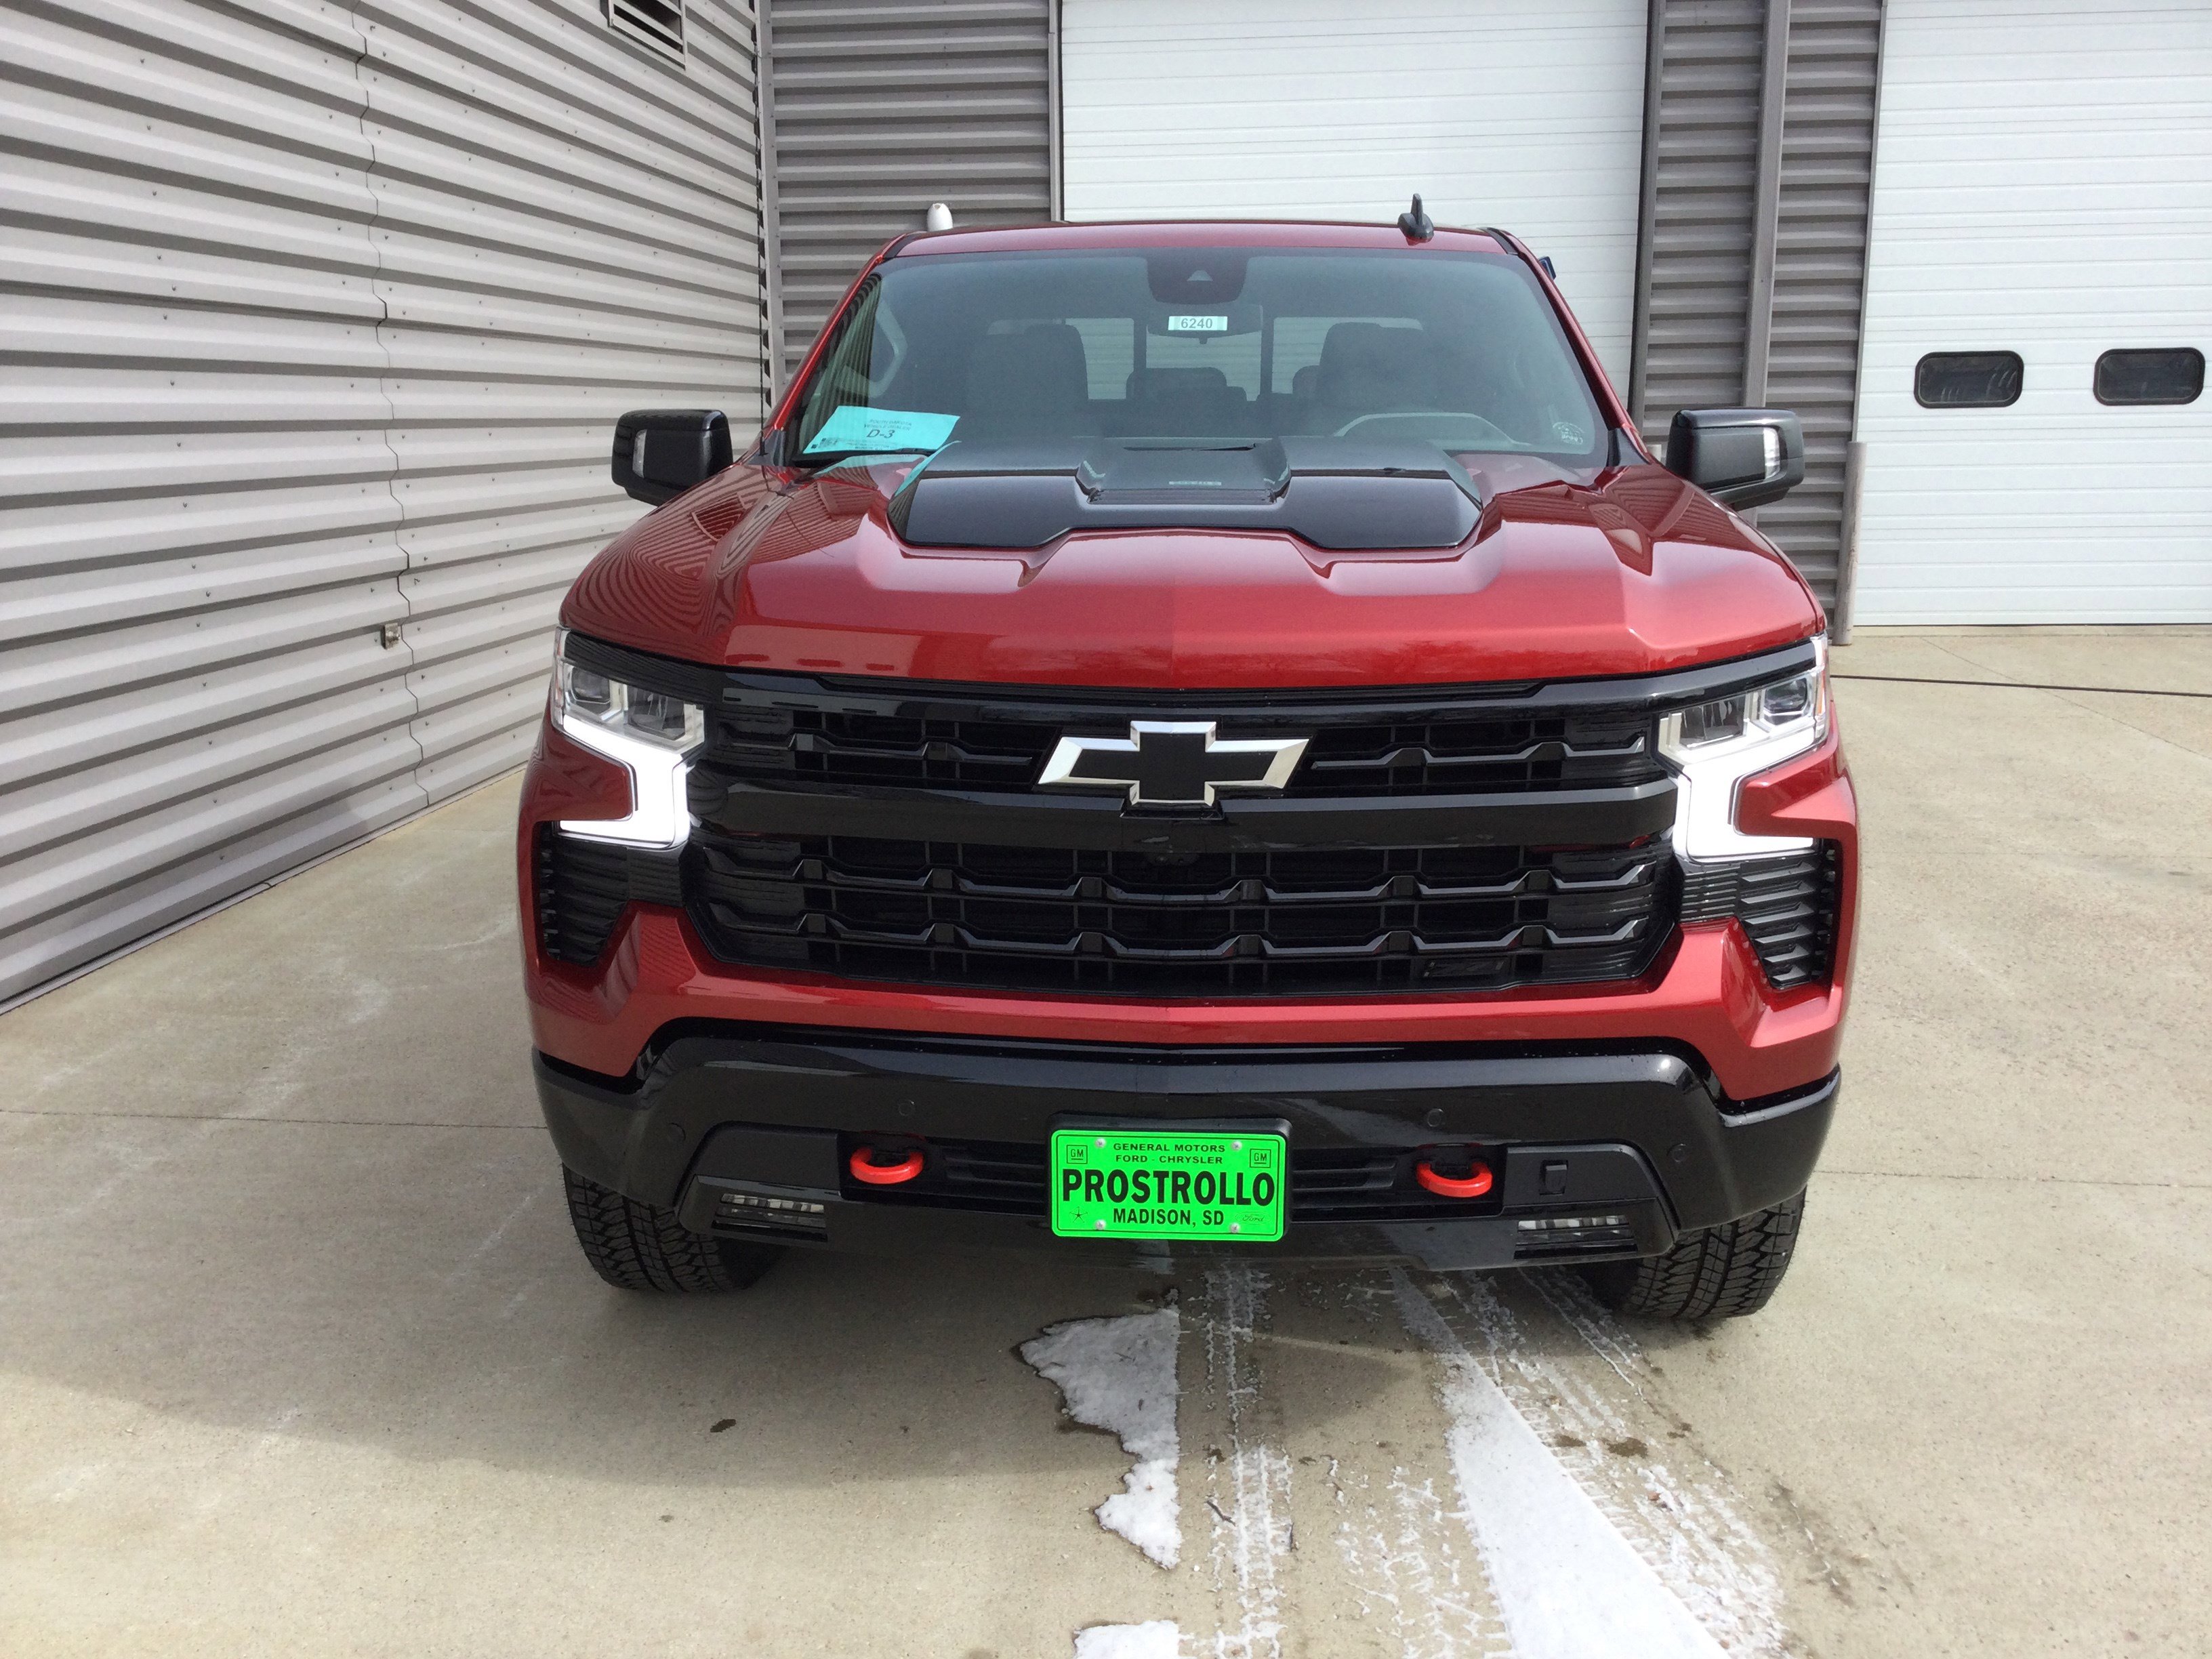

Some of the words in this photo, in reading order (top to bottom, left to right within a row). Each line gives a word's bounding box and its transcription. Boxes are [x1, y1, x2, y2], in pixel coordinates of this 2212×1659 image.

[1181, 318, 1213, 329] 6240
[866, 429, 895, 438] D-3
[1070, 1148, 1084, 1158] GM
[1113, 1143, 1170, 1151] GENERAL
[1174, 1144, 1225, 1153] MOTORS
[1115, 1154, 1147, 1163] FORD
[1159, 1155, 1223, 1164] CHRYSLER
[1254, 1152, 1267, 1162] GM
[1062, 1168, 1275, 1206] PROSTROLLO
[1113, 1208, 1196, 1227] MADISON,
[1202, 1210, 1224, 1225] SD
[1242, 1213, 1265, 1222] Ford
